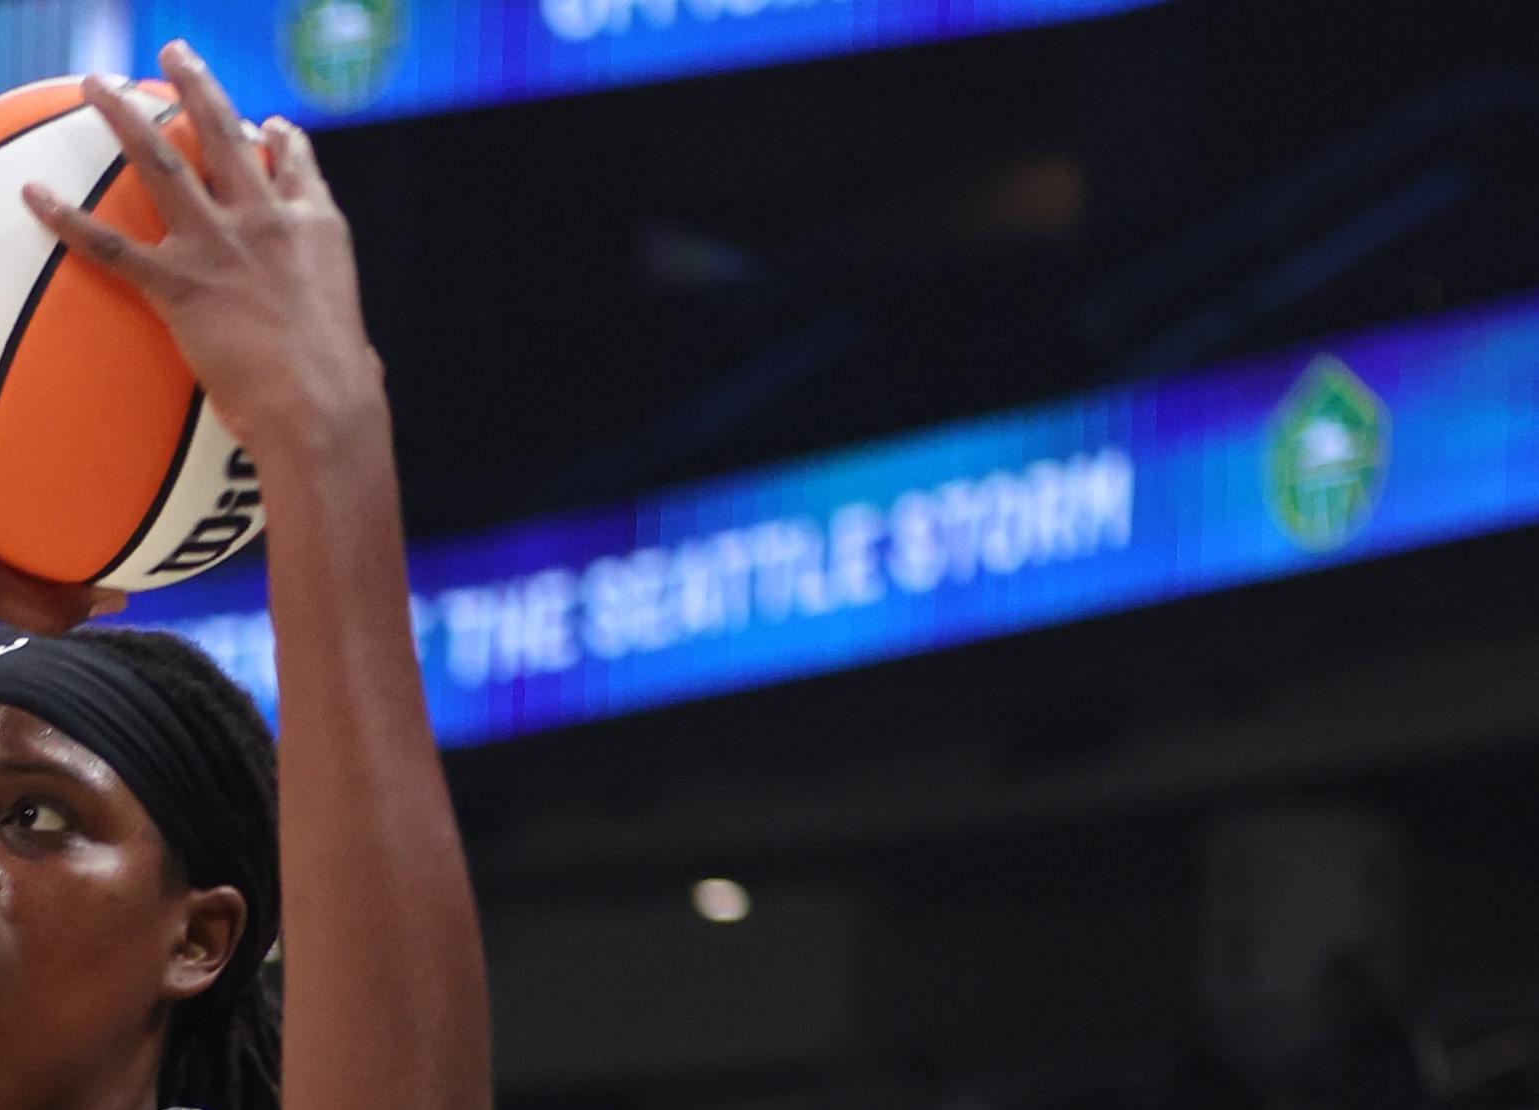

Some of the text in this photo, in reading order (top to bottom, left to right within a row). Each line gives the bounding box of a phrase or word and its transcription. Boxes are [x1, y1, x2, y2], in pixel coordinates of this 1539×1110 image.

[444, 570, 582, 688] THE
[582, 500, 888, 660] SEATTLE
[886, 447, 1135, 596] STORM
